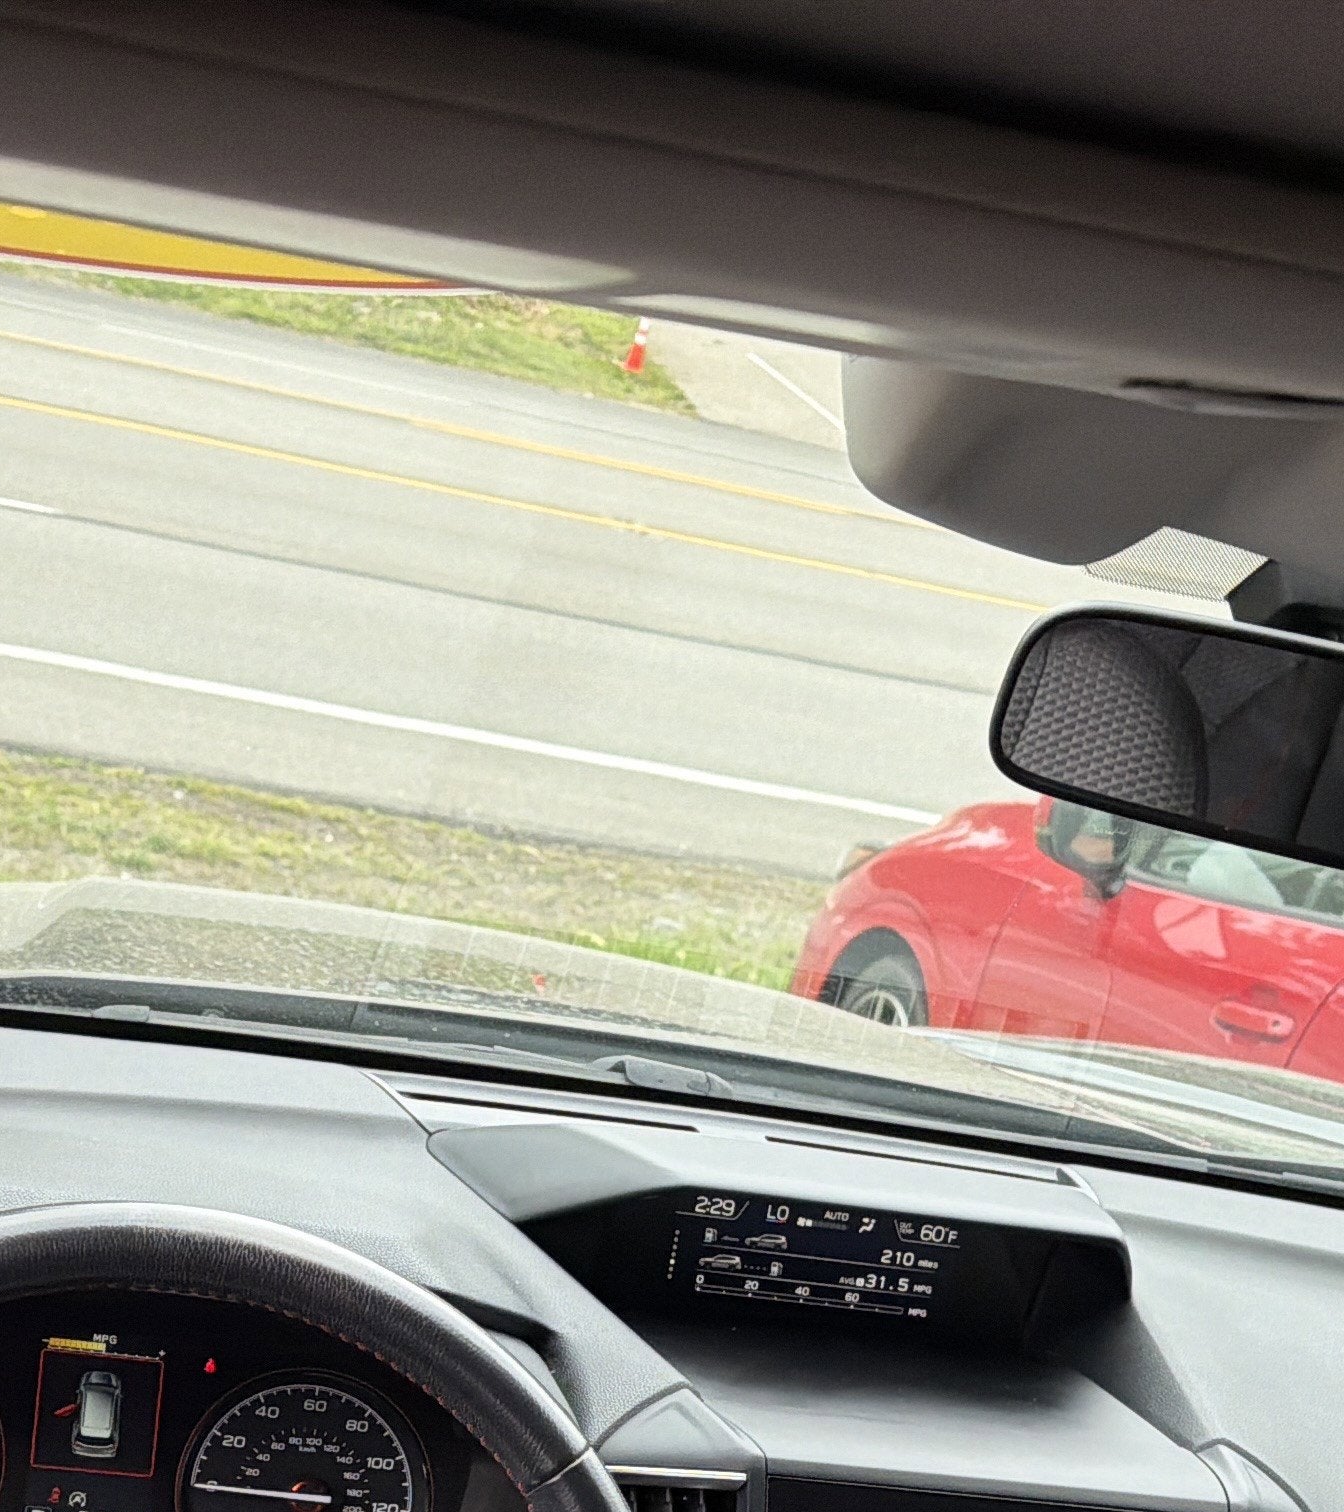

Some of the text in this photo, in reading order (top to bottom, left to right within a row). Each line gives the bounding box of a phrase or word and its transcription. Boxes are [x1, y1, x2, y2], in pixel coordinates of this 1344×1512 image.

[694, 1196, 736, 1217] 2:29
[766, 1204, 790, 1222] LO
[823, 1210, 850, 1222] AUTO
[880, 1249, 915, 1267] 210
[695, 1274, 705, 1285] 0
[744, 1280, 759, 1291] 20
[864, 1273, 910, 1293] 31.5
[912, 1284, 933, 1295] MPG
[794, 1285, 810, 1297] 40
[844, 1291, 860, 1303] 60
[907, 1307, 928, 1318] MPG
[92, 1333, 118, 1345] MPG
[303, 1399, 327, 1413] 60
[255, 1406, 280, 1419] 40
[345, 1419, 369, 1433] 80
[222, 1435, 246, 1448] 20
[305, 1437, 323, 1446] 100
[256, 1452, 271, 1462] 40
[366, 1456, 395, 1471] 100
[245, 1467, 261, 1477] 20
